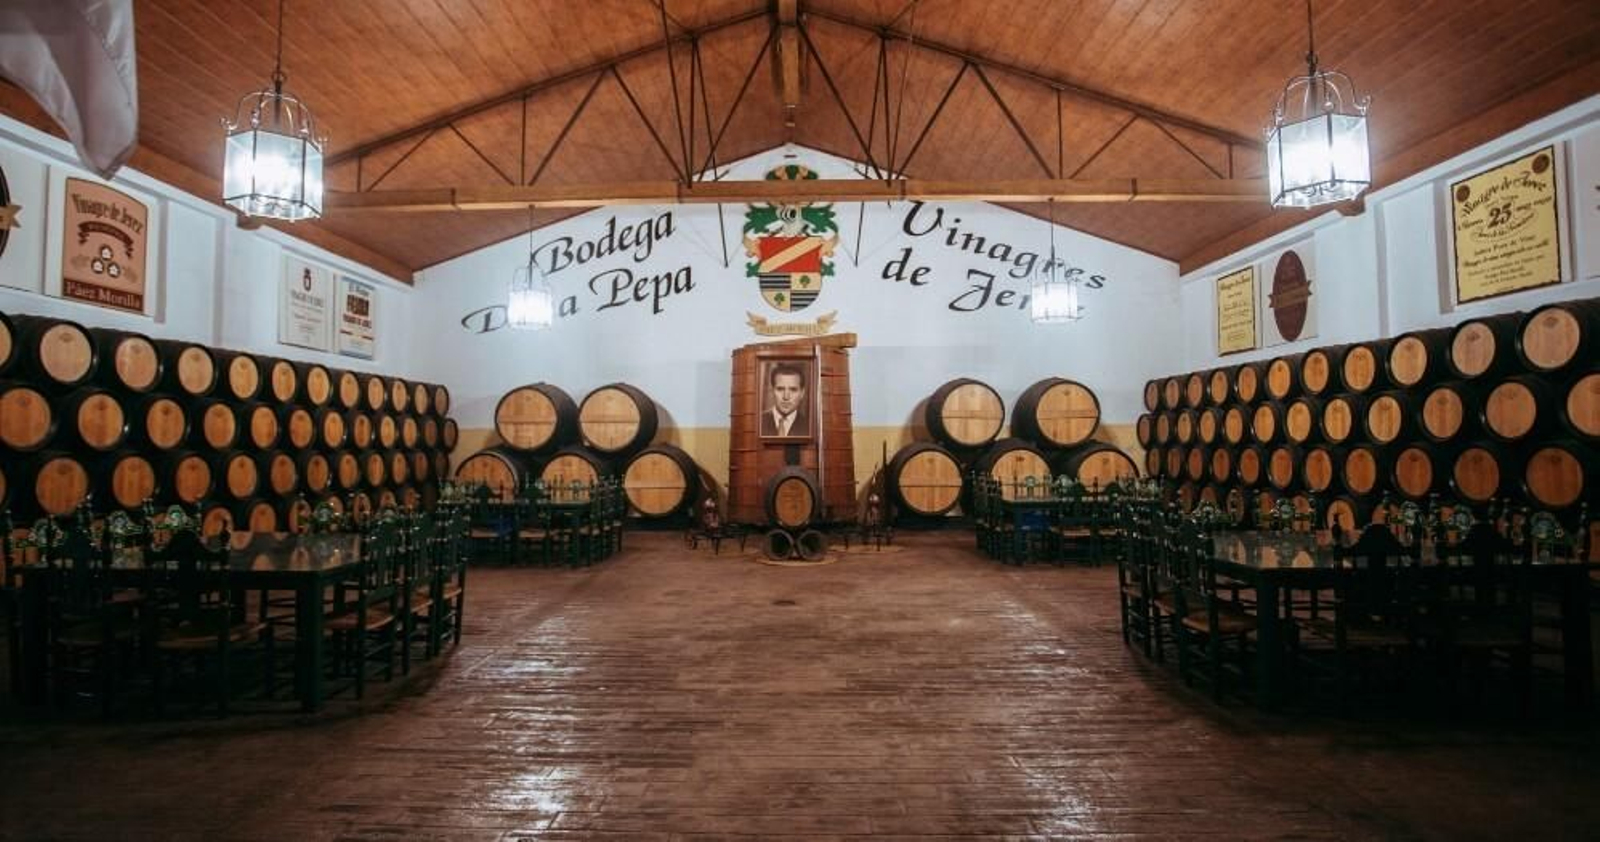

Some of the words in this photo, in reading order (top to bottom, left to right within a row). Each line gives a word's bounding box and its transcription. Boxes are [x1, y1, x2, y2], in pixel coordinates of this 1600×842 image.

[72, 193, 108, 218] Vinagre
[121, 207, 144, 234] Jerez
[1487, 202, 1512, 229] 25
[532, 210, 676, 277] Bodega
[902, 200, 1106, 290] Vinagres
[882, 247, 931, 286] de
[589, 265, 697, 314] Pepa
